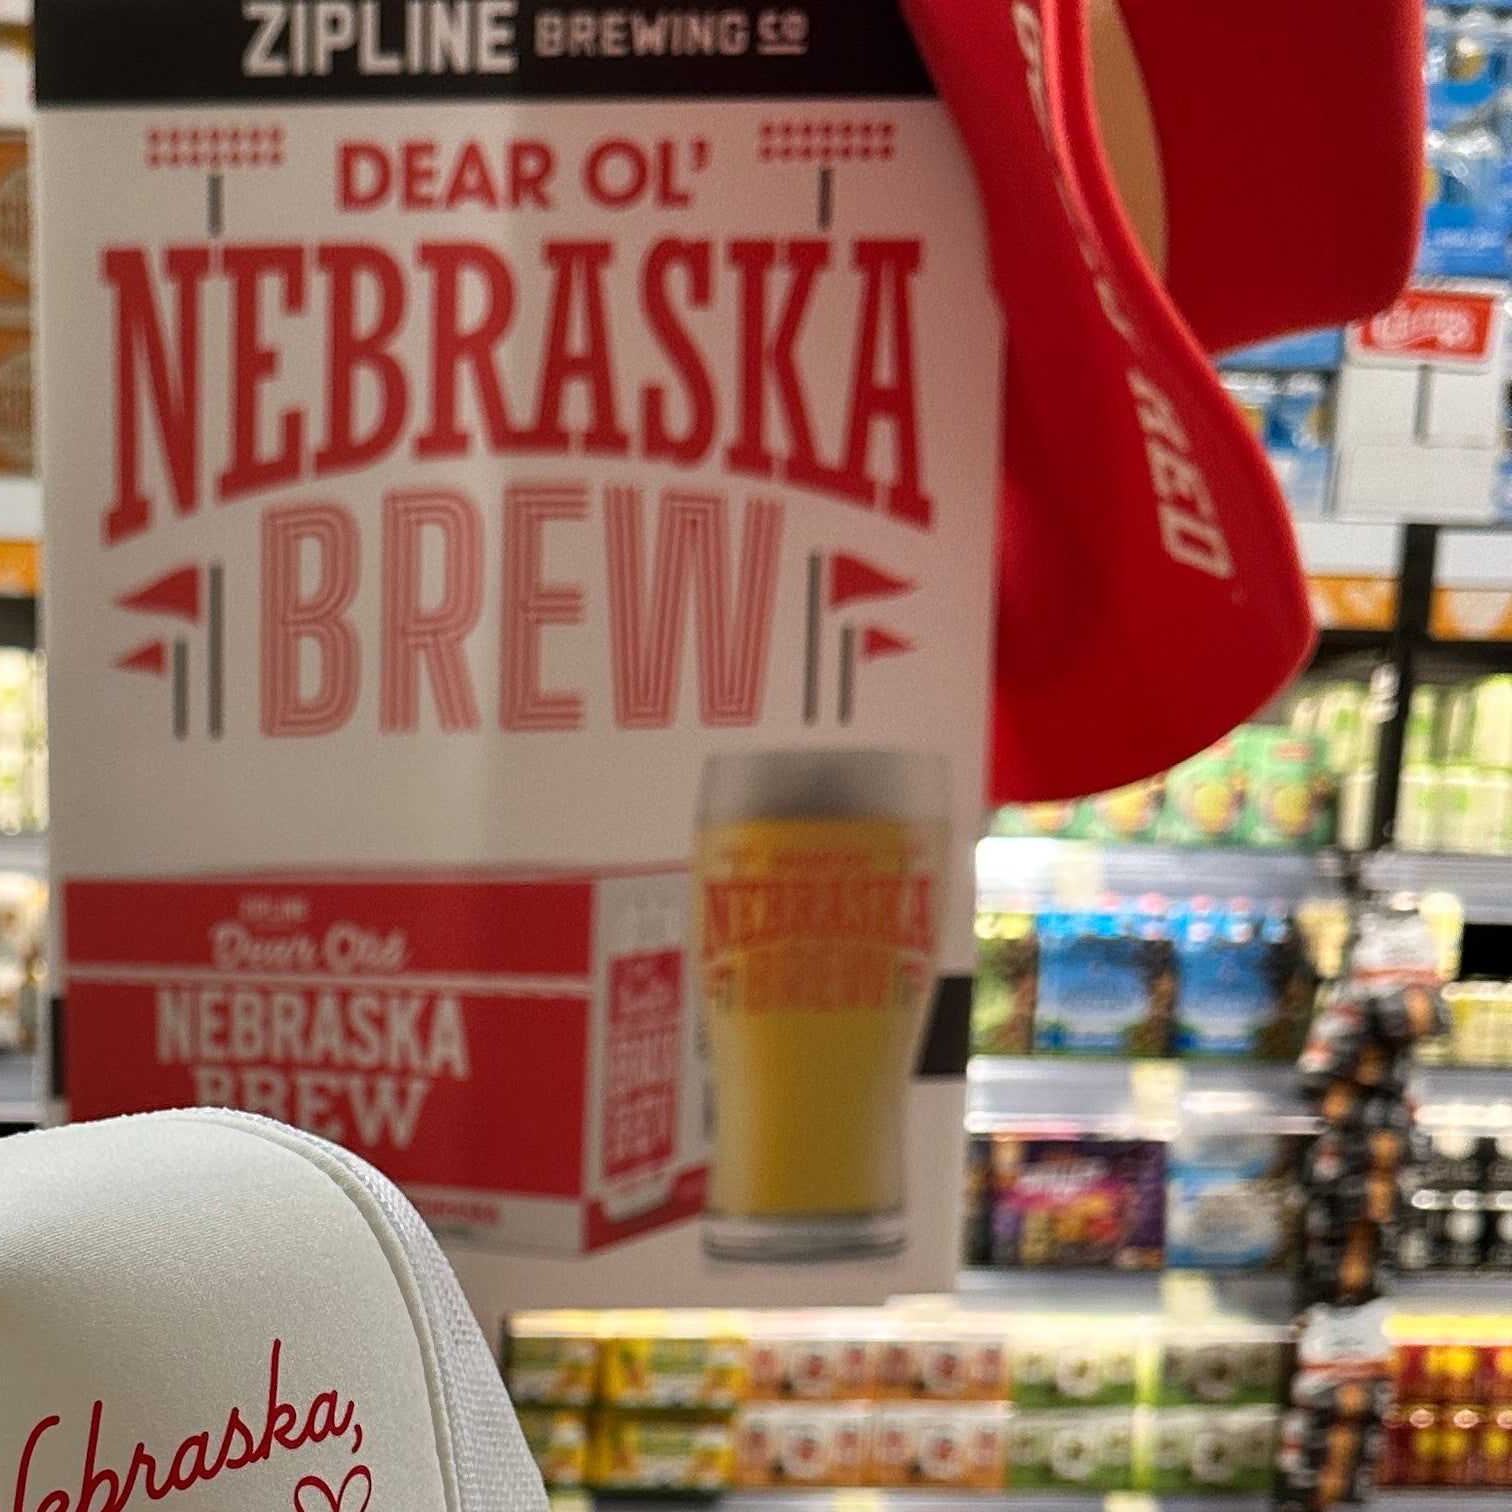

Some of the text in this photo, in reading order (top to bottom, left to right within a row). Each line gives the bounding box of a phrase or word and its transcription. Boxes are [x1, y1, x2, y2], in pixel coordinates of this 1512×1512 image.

[242, 0, 518, 76] ZIPLINE
[535, 11, 748, 57] BREWING
[337, 137, 711, 212] DEAR OL'
[101, 235, 935, 547] NEBRASKA
[259, 483, 785, 738] BREW
[155, 988, 470, 1081] NEBRASKA
